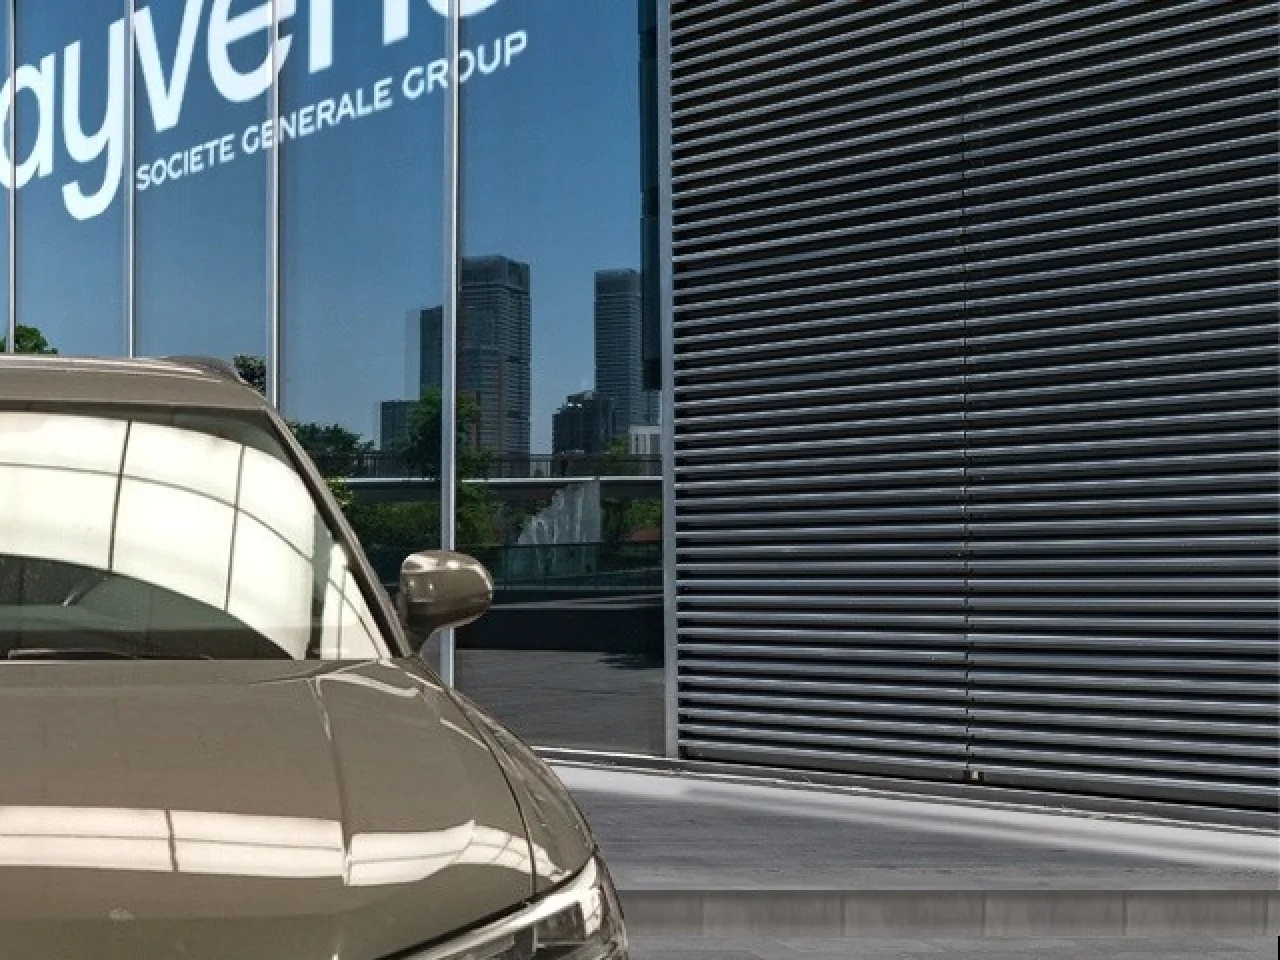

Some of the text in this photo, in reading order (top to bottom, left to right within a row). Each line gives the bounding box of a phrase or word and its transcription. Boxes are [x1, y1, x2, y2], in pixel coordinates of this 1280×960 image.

[135, 30, 528, 191] SOCIETE GENERALE GROUP
